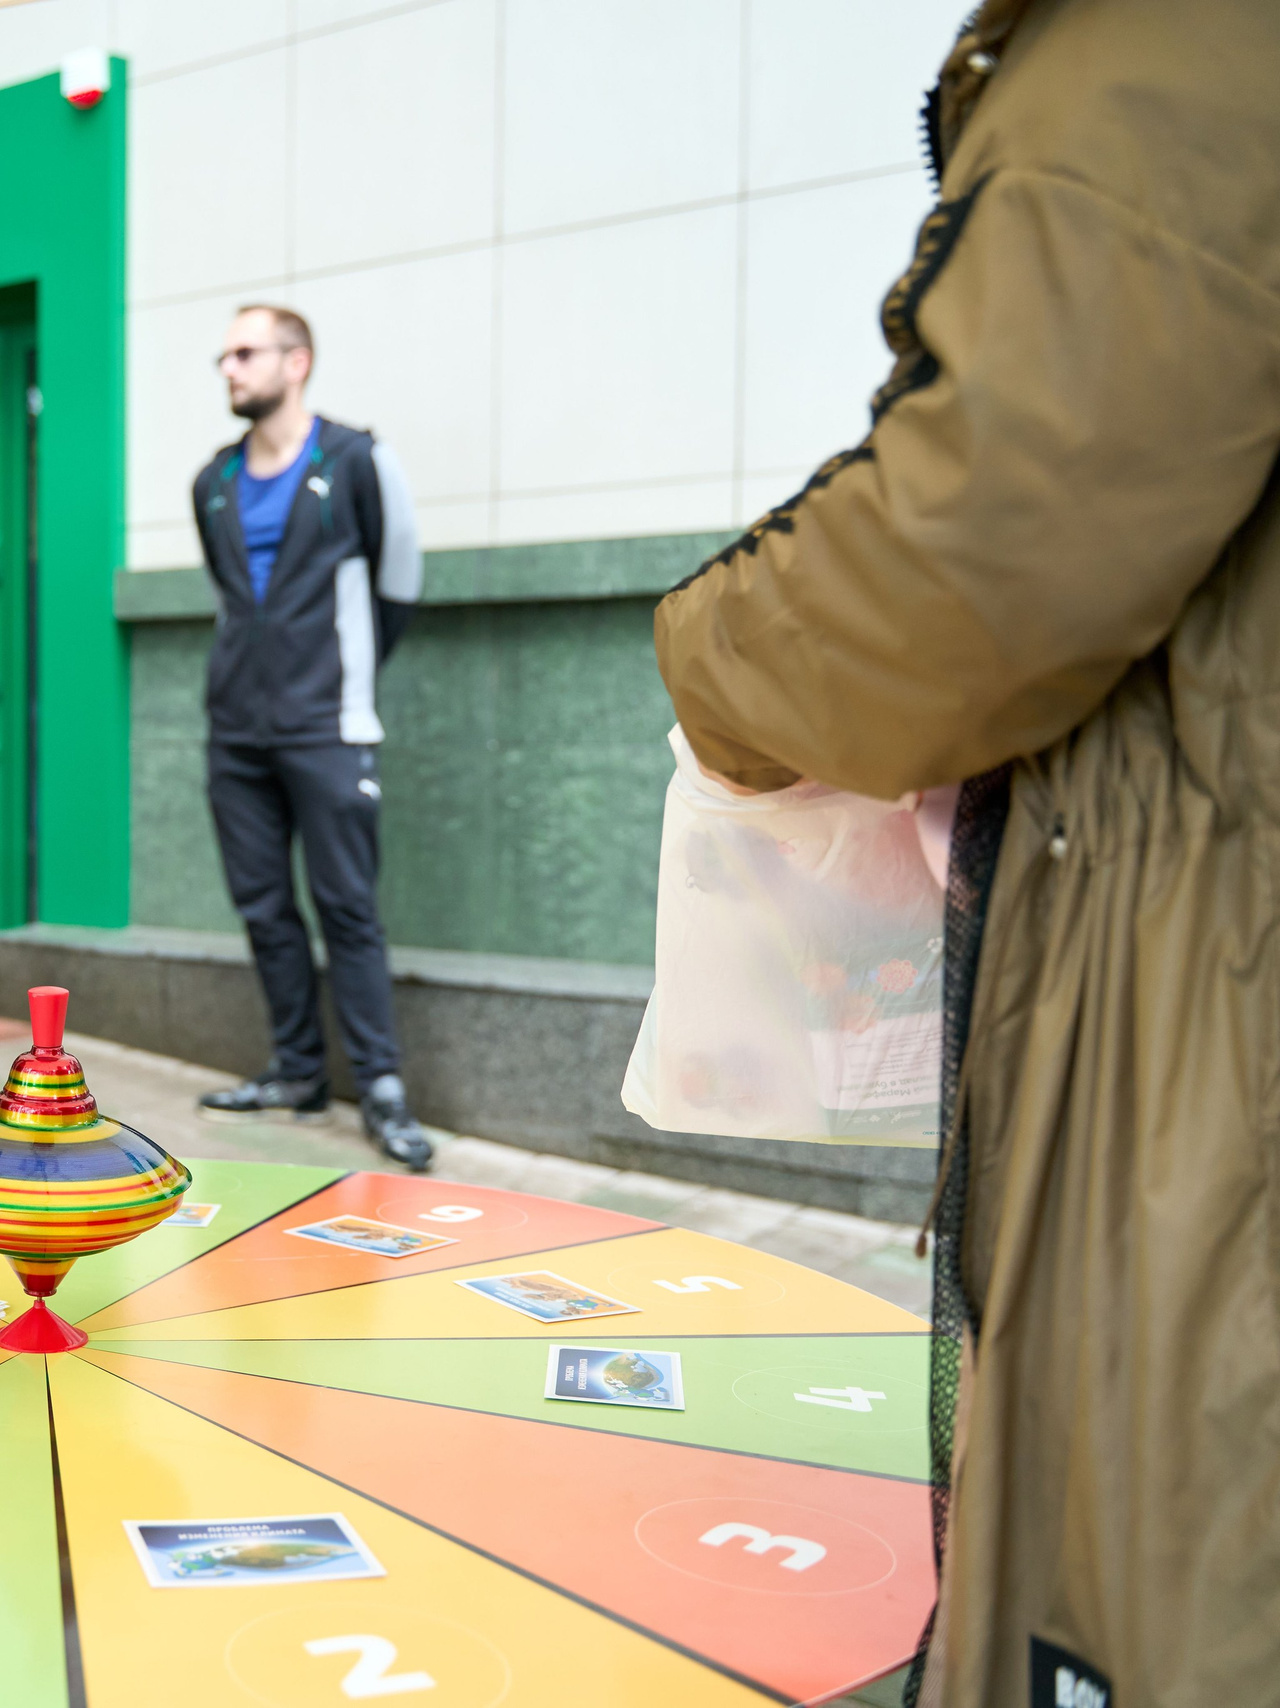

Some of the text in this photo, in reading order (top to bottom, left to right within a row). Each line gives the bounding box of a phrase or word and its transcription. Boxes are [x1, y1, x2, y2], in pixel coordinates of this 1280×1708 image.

[417, 1205, 484, 1223] 6
[652, 1275, 743, 1294] 5
[793, 1386, 887, 1413] 4
[207, 1524, 270, 1533] ПРОБЛЕМА
[699, 1522, 827, 1571] 3
[304, 1635, 435, 1698] 2
